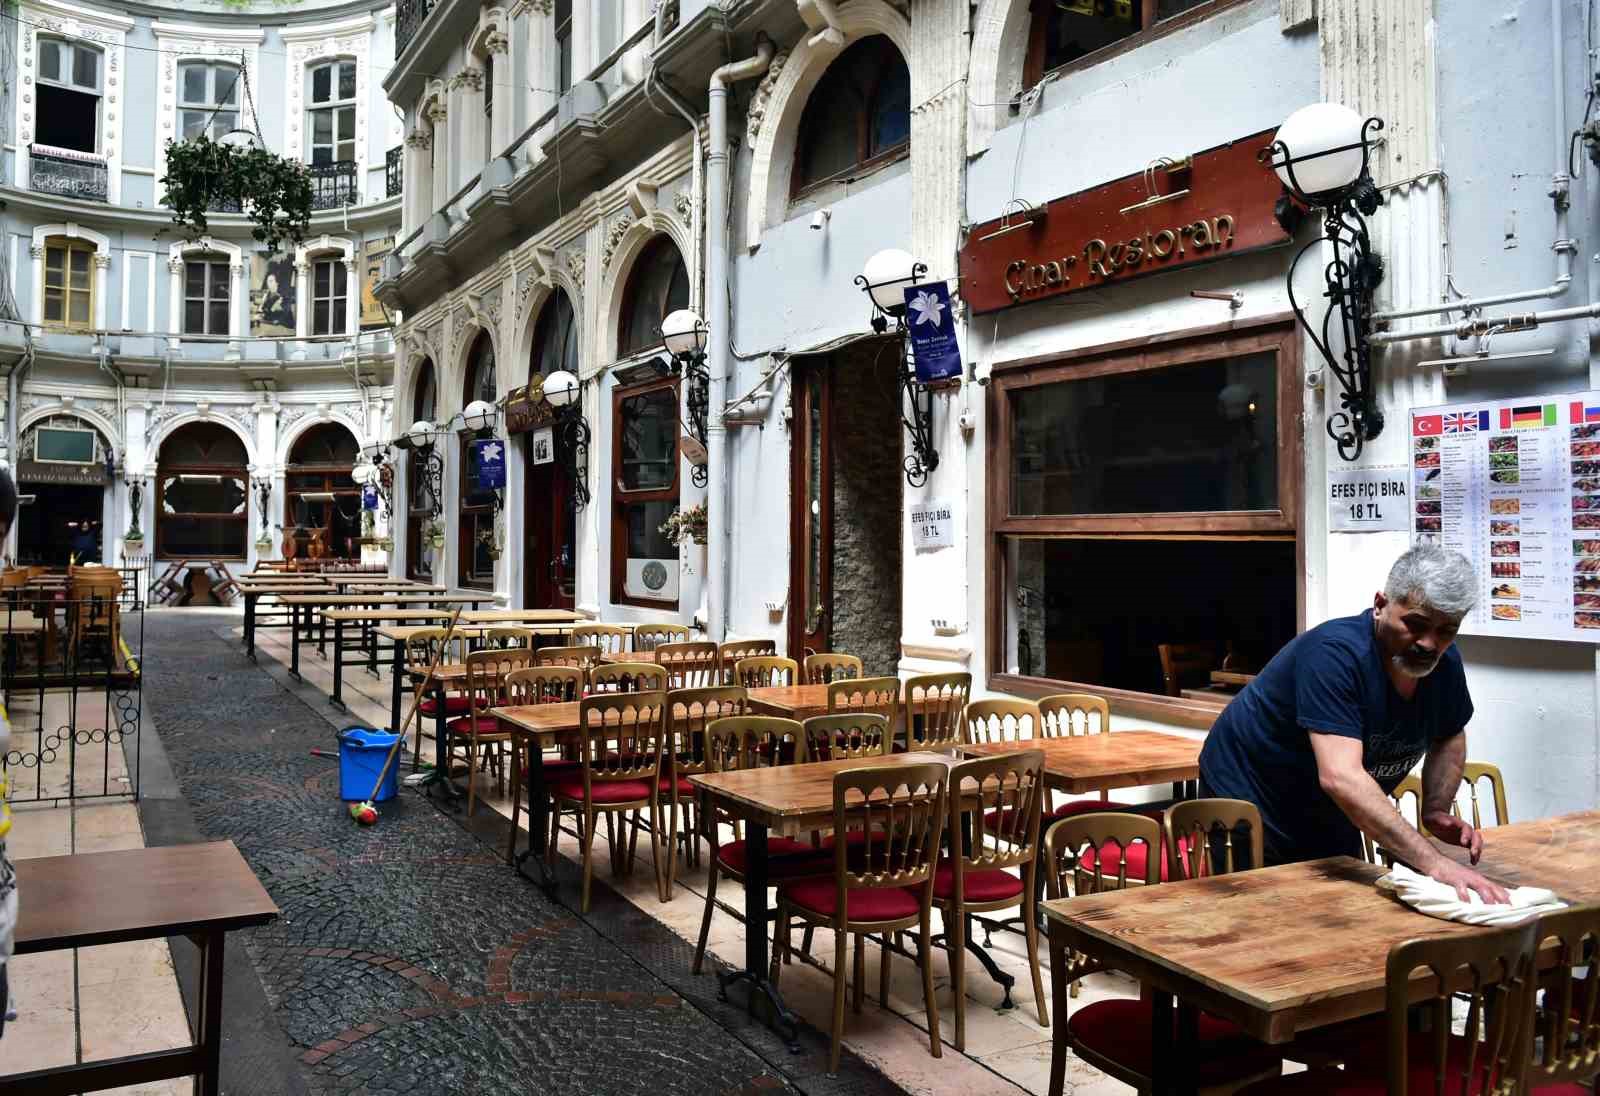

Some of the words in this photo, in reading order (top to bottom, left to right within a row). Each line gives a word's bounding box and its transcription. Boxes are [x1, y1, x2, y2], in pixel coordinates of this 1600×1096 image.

[1084, 214, 1234, 277] Restoran
[1331, 483, 1356, 498] EFES
[1381, 478, 1406, 497] BİRA
[937, 508, 950, 520] BİRA
[1350, 503, 1363, 519] 18
[1366, 503, 1382, 519] TL
[922, 525, 929, 536] 18
[930, 525, 940, 536] TL
